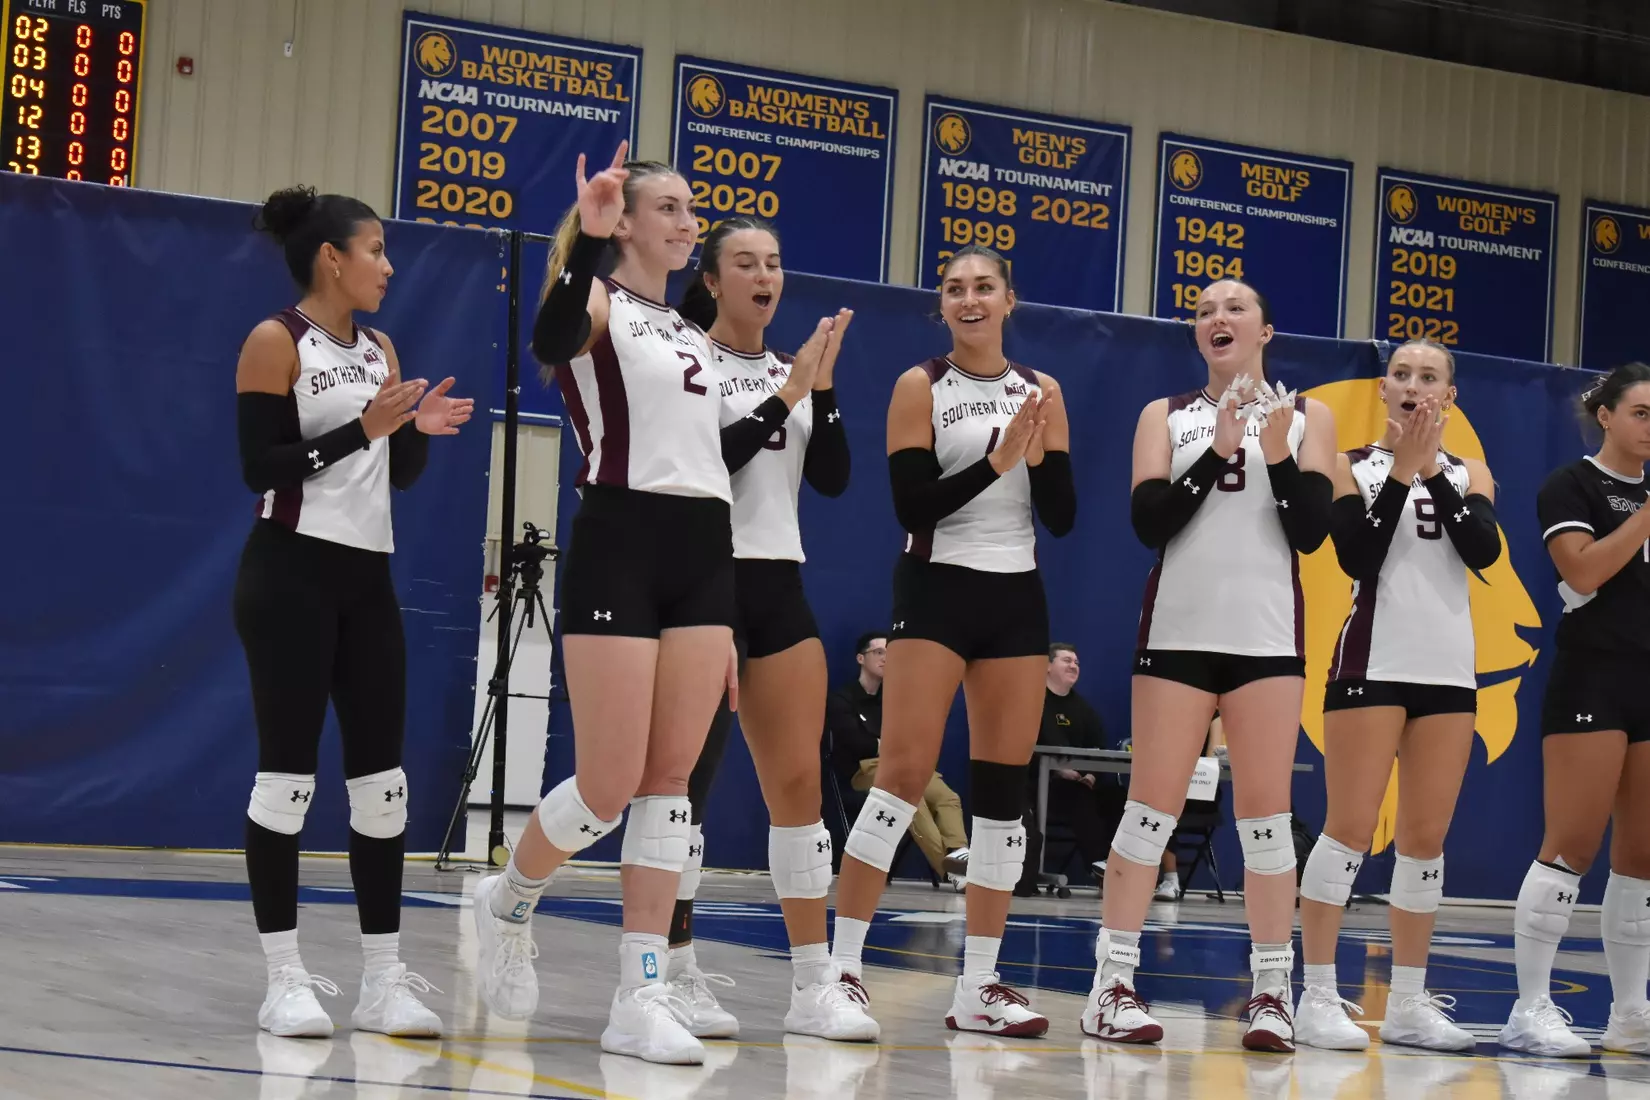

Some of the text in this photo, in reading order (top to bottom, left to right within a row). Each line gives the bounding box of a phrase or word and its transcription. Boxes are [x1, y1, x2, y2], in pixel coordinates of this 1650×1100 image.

[68, 0, 87, 14] FLS
[102, 4, 121, 19] PTS
[15, 15, 134, 55] 02 0 0
[13, 44, 132, 83] 03 0 0
[481, 44, 614, 82] WOMEN'S
[11, 74, 130, 113] 04 0 0
[461, 60, 631, 103] BASKETBALL
[418, 79, 621, 124] NCAA TOURNAMENT
[747, 84, 870, 119] WOMEN'S
[18, 105, 128, 141] 12 0 0
[421, 105, 518, 144] 2007
[728, 99, 886, 140] BASKETBALL
[16, 135, 126, 171] 13 0 0
[687, 121, 881, 160] CONFERENCE CHAMPIONSHIPS
[1012, 128, 1088, 155] MEN'S
[1018, 146, 1079, 170] GOLF
[419, 142, 507, 181] 2019
[692, 145, 782, 182] 2007
[938, 157, 1113, 198] NCAA TOURNAMENT
[1240, 162, 1311, 188] MEN'S
[416, 180, 514, 219] 2020
[691, 180, 780, 218] 2020
[941, 182, 1110, 230] 1998 2022
[1246, 180, 1303, 203] GOLF
[1169, 194, 1338, 229] CONFERENCE CHAMPIONSHIPS
[1435, 194, 1537, 225] WOMEN'S
[1459, 215, 1512, 236] GOLF
[940, 217, 1016, 251] 1999
[1175, 216, 1245, 250] 1942
[1388, 226, 1543, 262] NCAA TOURNAMENT
[1173, 249, 1245, 281] 1964
[1391, 248, 1458, 280] 2019
[1592, 257, 1650, 274] CONFERENC
[1389, 280, 1454, 313] 2021
[1387, 313, 1460, 345] 2022
[311, 365, 366, 396] SOUTHERN
[674, 350, 708, 396] 2
[718, 377, 767, 398] OUTHERN
[941, 399, 998, 429] SOUTHERN
[1178, 425, 1215, 449] SOUTH
[1412, 498, 1443, 540] 9
